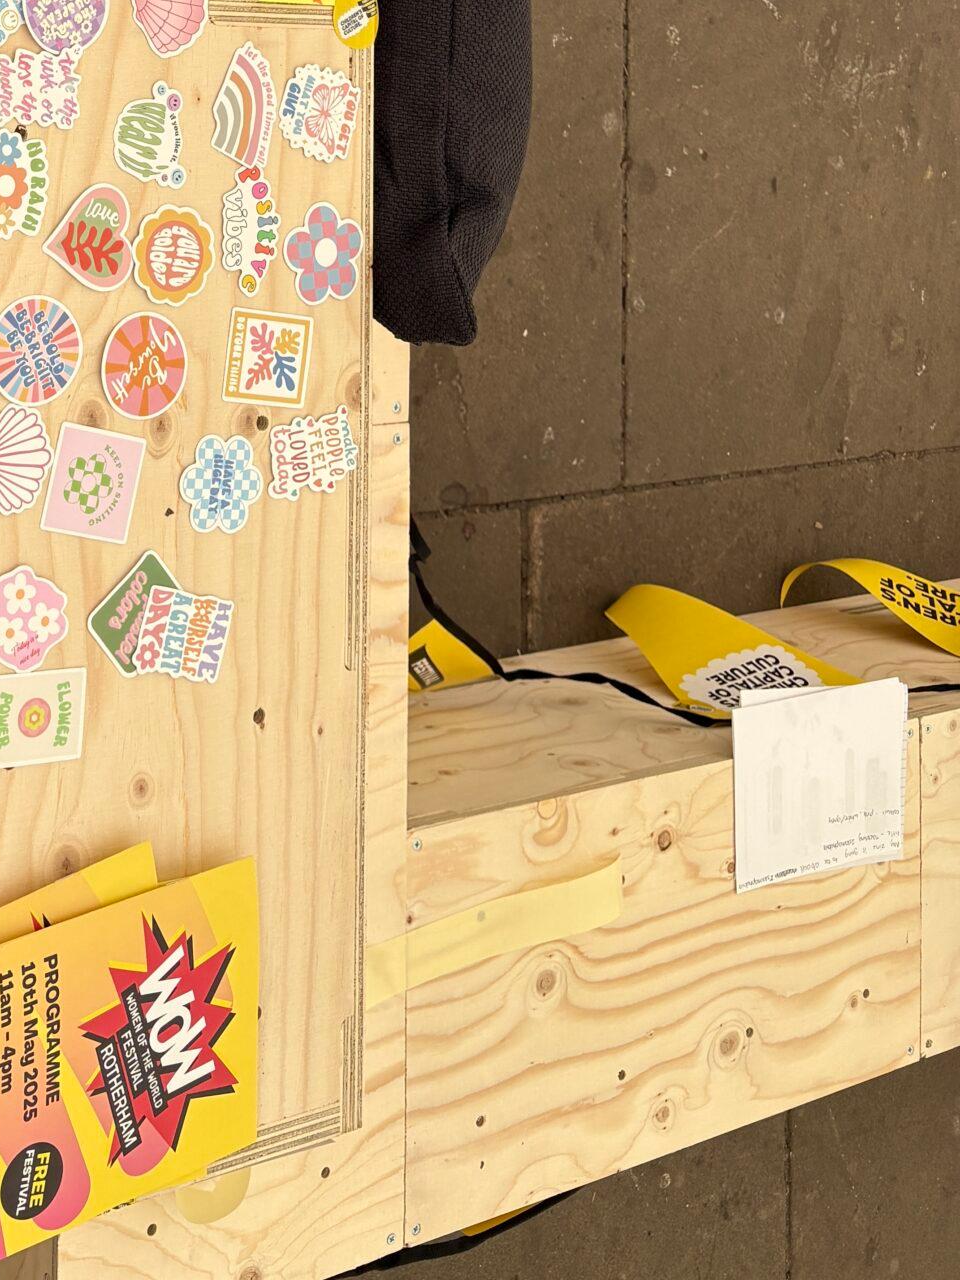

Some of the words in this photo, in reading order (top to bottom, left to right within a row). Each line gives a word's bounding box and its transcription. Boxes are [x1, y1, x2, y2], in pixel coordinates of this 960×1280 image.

[343, 91, 358, 121] YOU
[26, 142, 46, 172] NO
[336, 124, 351, 155] GET
[21, 177, 46, 231] RAIN
[225, 189, 248, 268] vibes
[15, 308, 32, 330] BE
[34, 310, 48, 332] BE
[41, 330, 65, 378] BOLD
[20, 329, 55, 390] BRIGHT
[112, 320, 176, 403] Yourself
[273, 428, 293, 494] today
[308, 428, 326, 476] FEEL
[142, 588, 174, 649] DAY
[173, 593, 193, 606] A
[160, 610, 189, 673] GREAT
[197, 602, 232, 679] HAVE
[705, 654, 779, 685] CULTURE.
[708, 689, 732, 701] OF
[53, 681, 72, 747] FLOWER
[0, 970, 14, 1028] 11am
[21, 962, 39, 1016] 10th
[126, 992, 144, 1032] WOMEN
[20, 1020, 38, 1066] May
[43, 954, 61, 1106] PROGRAMME
[136, 1033, 149, 1049] OF
[138, 945, 216, 1095] WOW
[121, 1030, 142, 1091] FESTIVAL
[140, 1051, 154, 1072] THE
[23, 1069, 38, 1122] 2025
[100, 1043, 136, 1148] ROTHERHAM
[146, 1074, 164, 1109] WORLD
[16, 1149, 36, 1216] FESTIVAL
[29, 1152, 51, 1207] FREE
